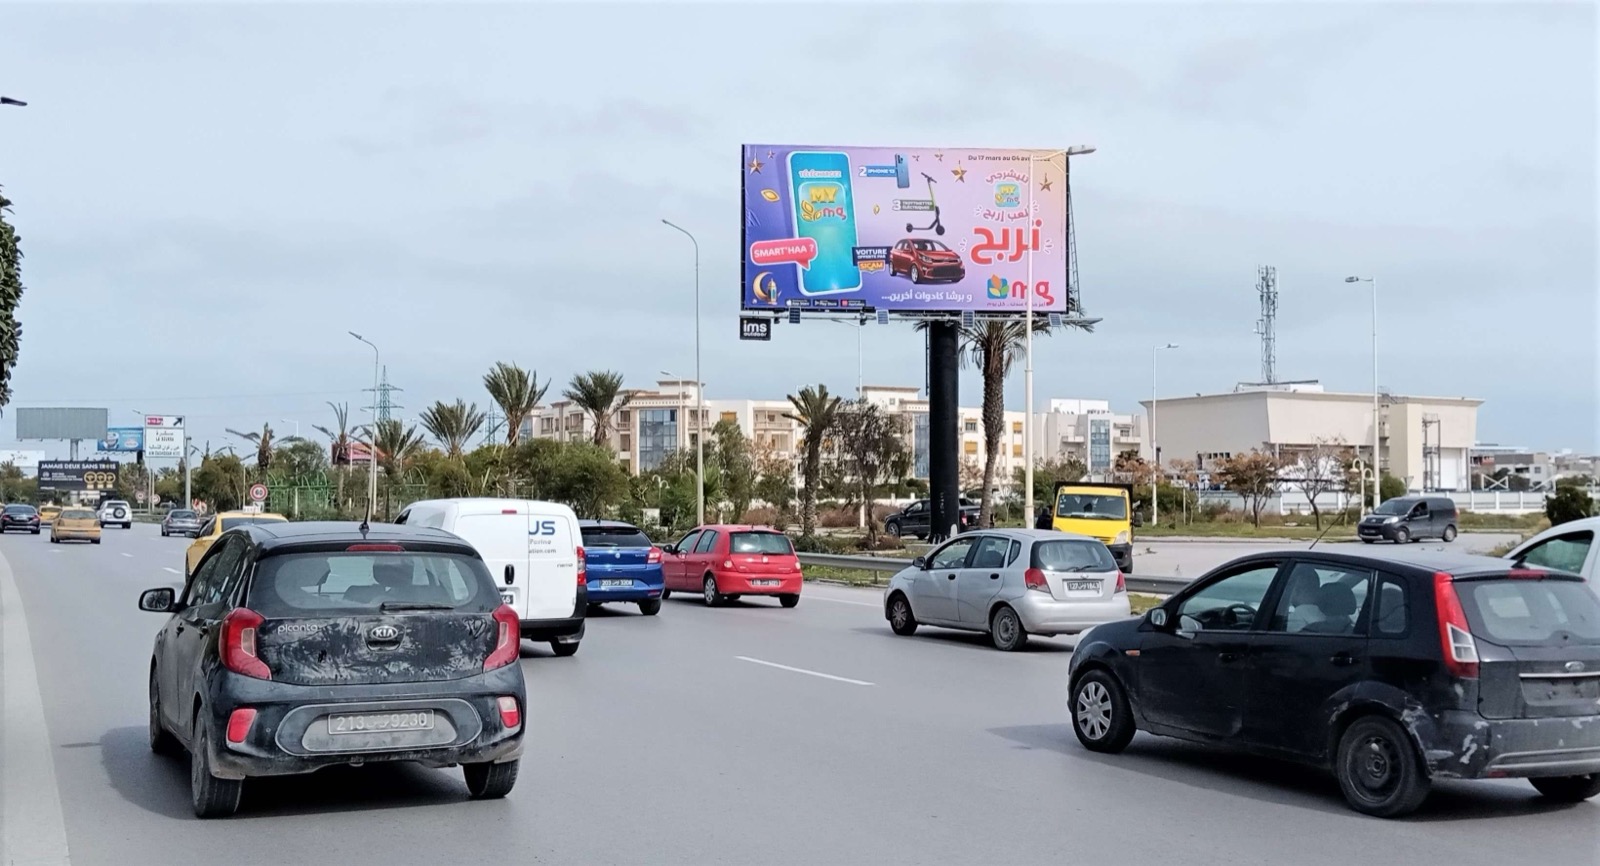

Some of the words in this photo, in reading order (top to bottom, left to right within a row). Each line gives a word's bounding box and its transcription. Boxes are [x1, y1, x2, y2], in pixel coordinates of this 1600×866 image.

[859, 166, 868, 177] 2
[809, 186, 838, 203] MY
[892, 199, 900, 210] 3
[823, 207, 846, 220] mg
[1008, 208, 1030, 221] لعب
[809, 244, 815, 252] ?
[914, 291, 944, 302] كادوات
[946, 290, 964, 302] برشا
[966, 293, 973, 302] و
[1012, 281, 1054, 306] mg
[743, 320, 767, 332] ims
[278, 624, 318, 634] picanto
[375, 628, 394, 637] KIA
[336, 716, 364, 730] 213
[391, 712, 427, 728] 9230
